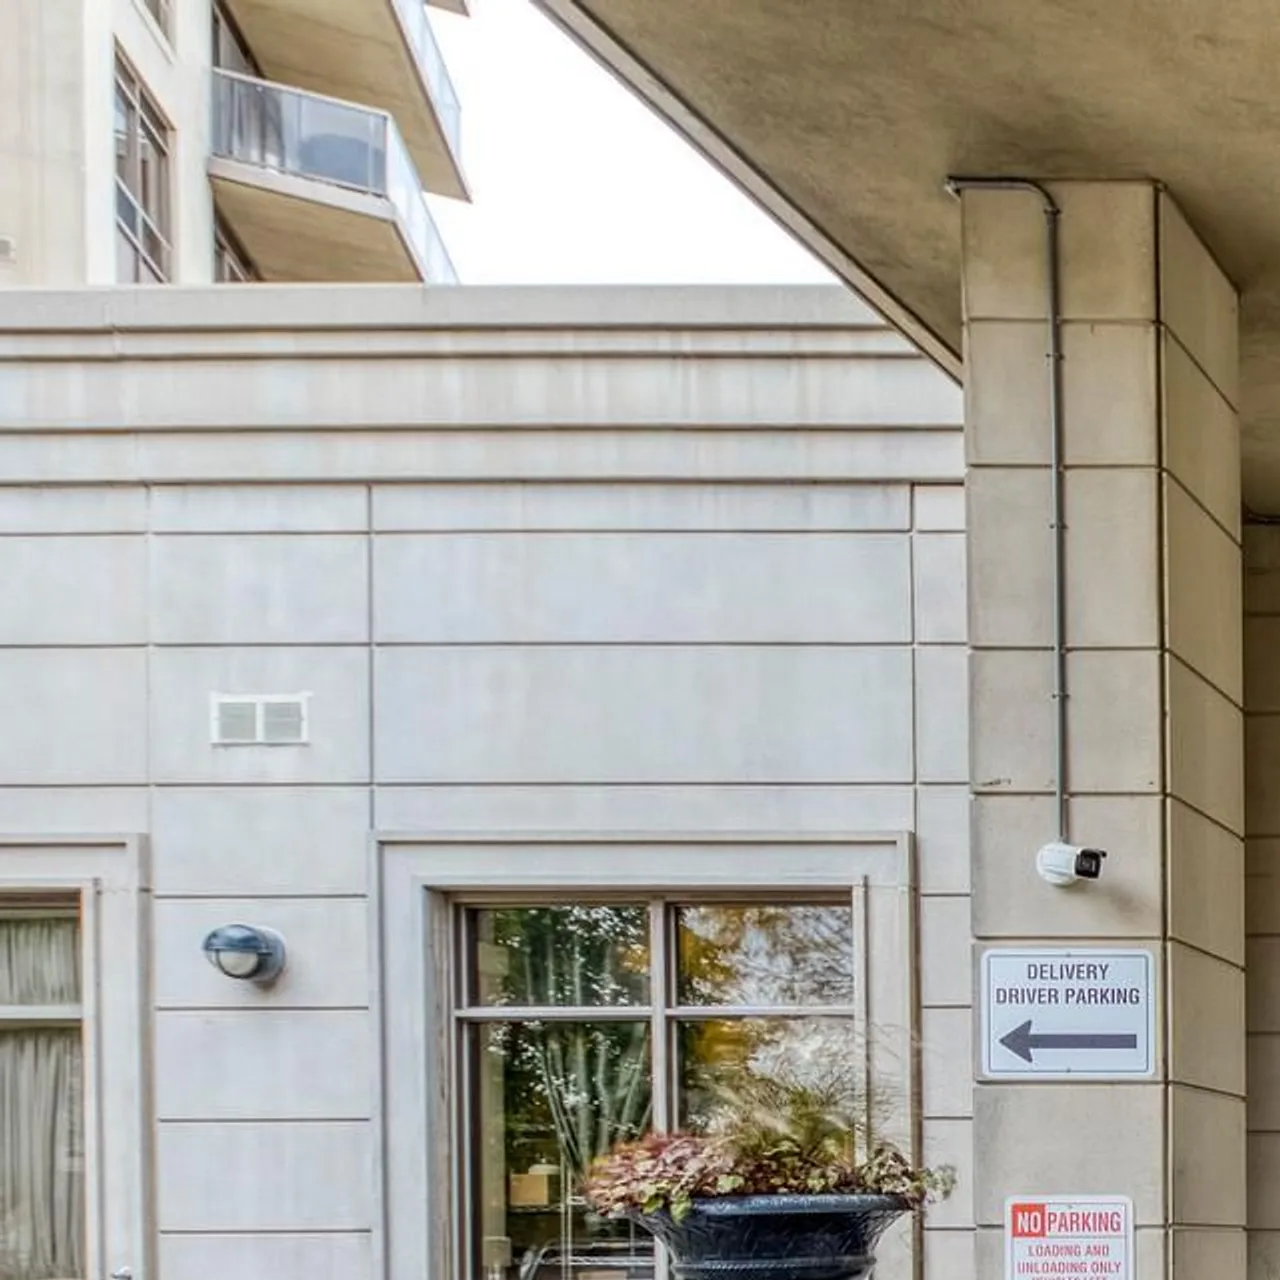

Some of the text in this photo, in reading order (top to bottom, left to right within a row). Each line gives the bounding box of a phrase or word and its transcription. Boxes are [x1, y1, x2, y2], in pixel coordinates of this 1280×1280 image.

[1027, 963, 1109, 981] DELIVERY
[996, 987, 1140, 1005] DRIVER PARKING
[1017, 1211, 1122, 1233] NO PARKING
[1028, 1244, 1109, 1257] LOADING AND
[1017, 1262, 1122, 1274] UNLOADING ONLY
